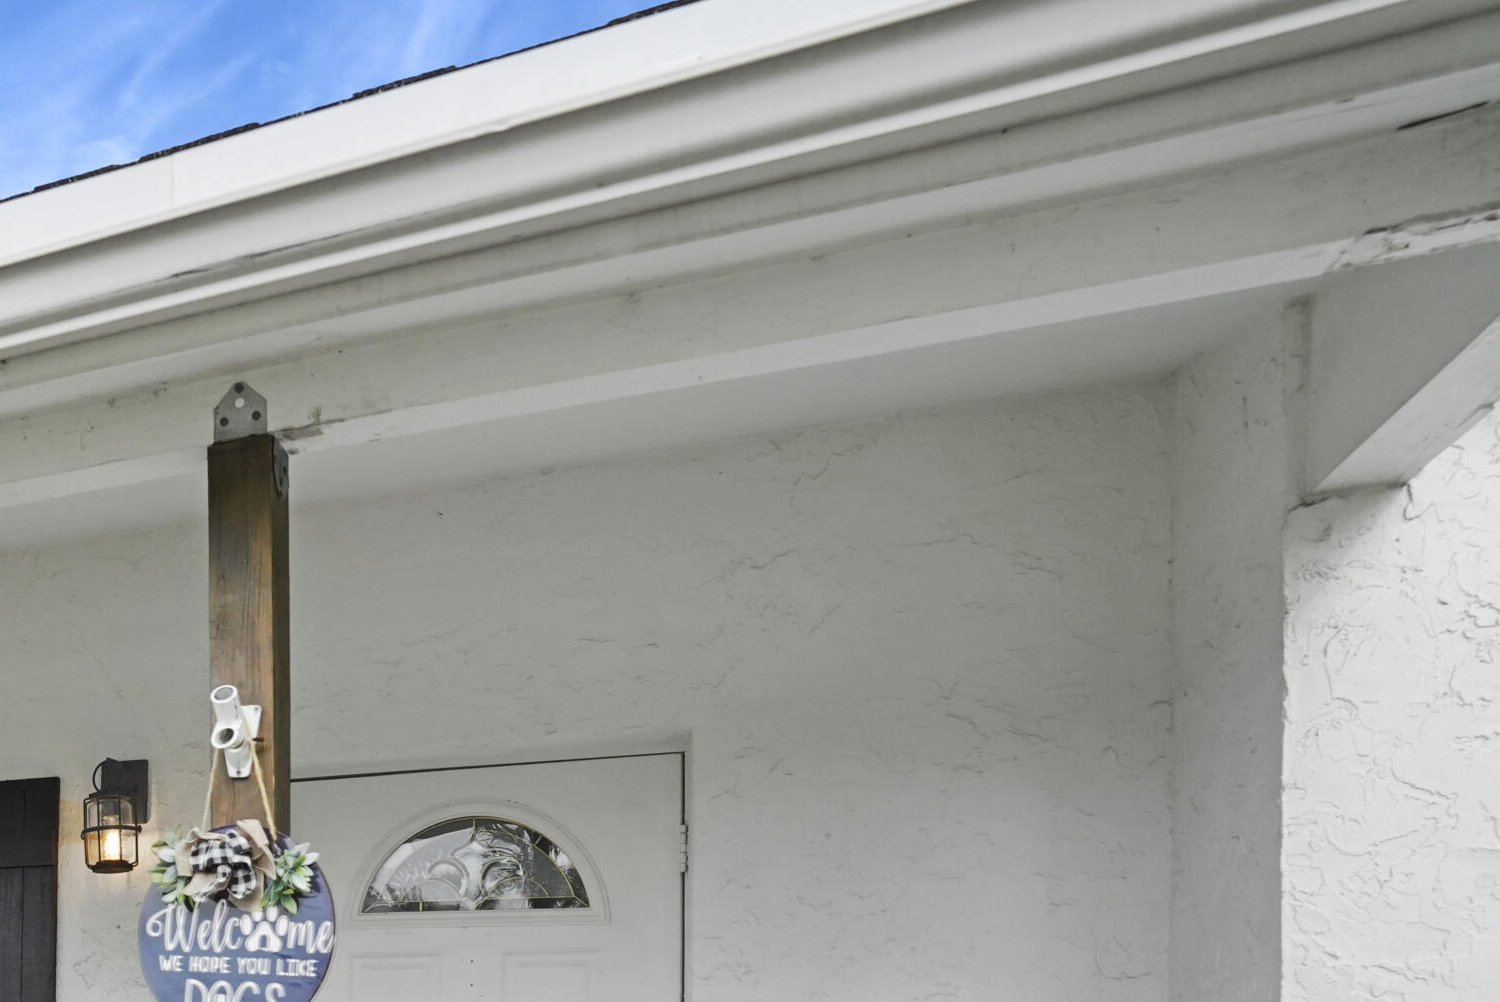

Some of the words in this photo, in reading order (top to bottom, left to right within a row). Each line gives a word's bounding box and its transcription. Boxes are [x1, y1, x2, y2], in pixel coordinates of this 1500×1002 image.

[159, 954, 185, 972] WE
[189, 956, 231, 974] HOPE
[237, 957, 272, 975] YOU
[276, 959, 319, 977] LIKE
